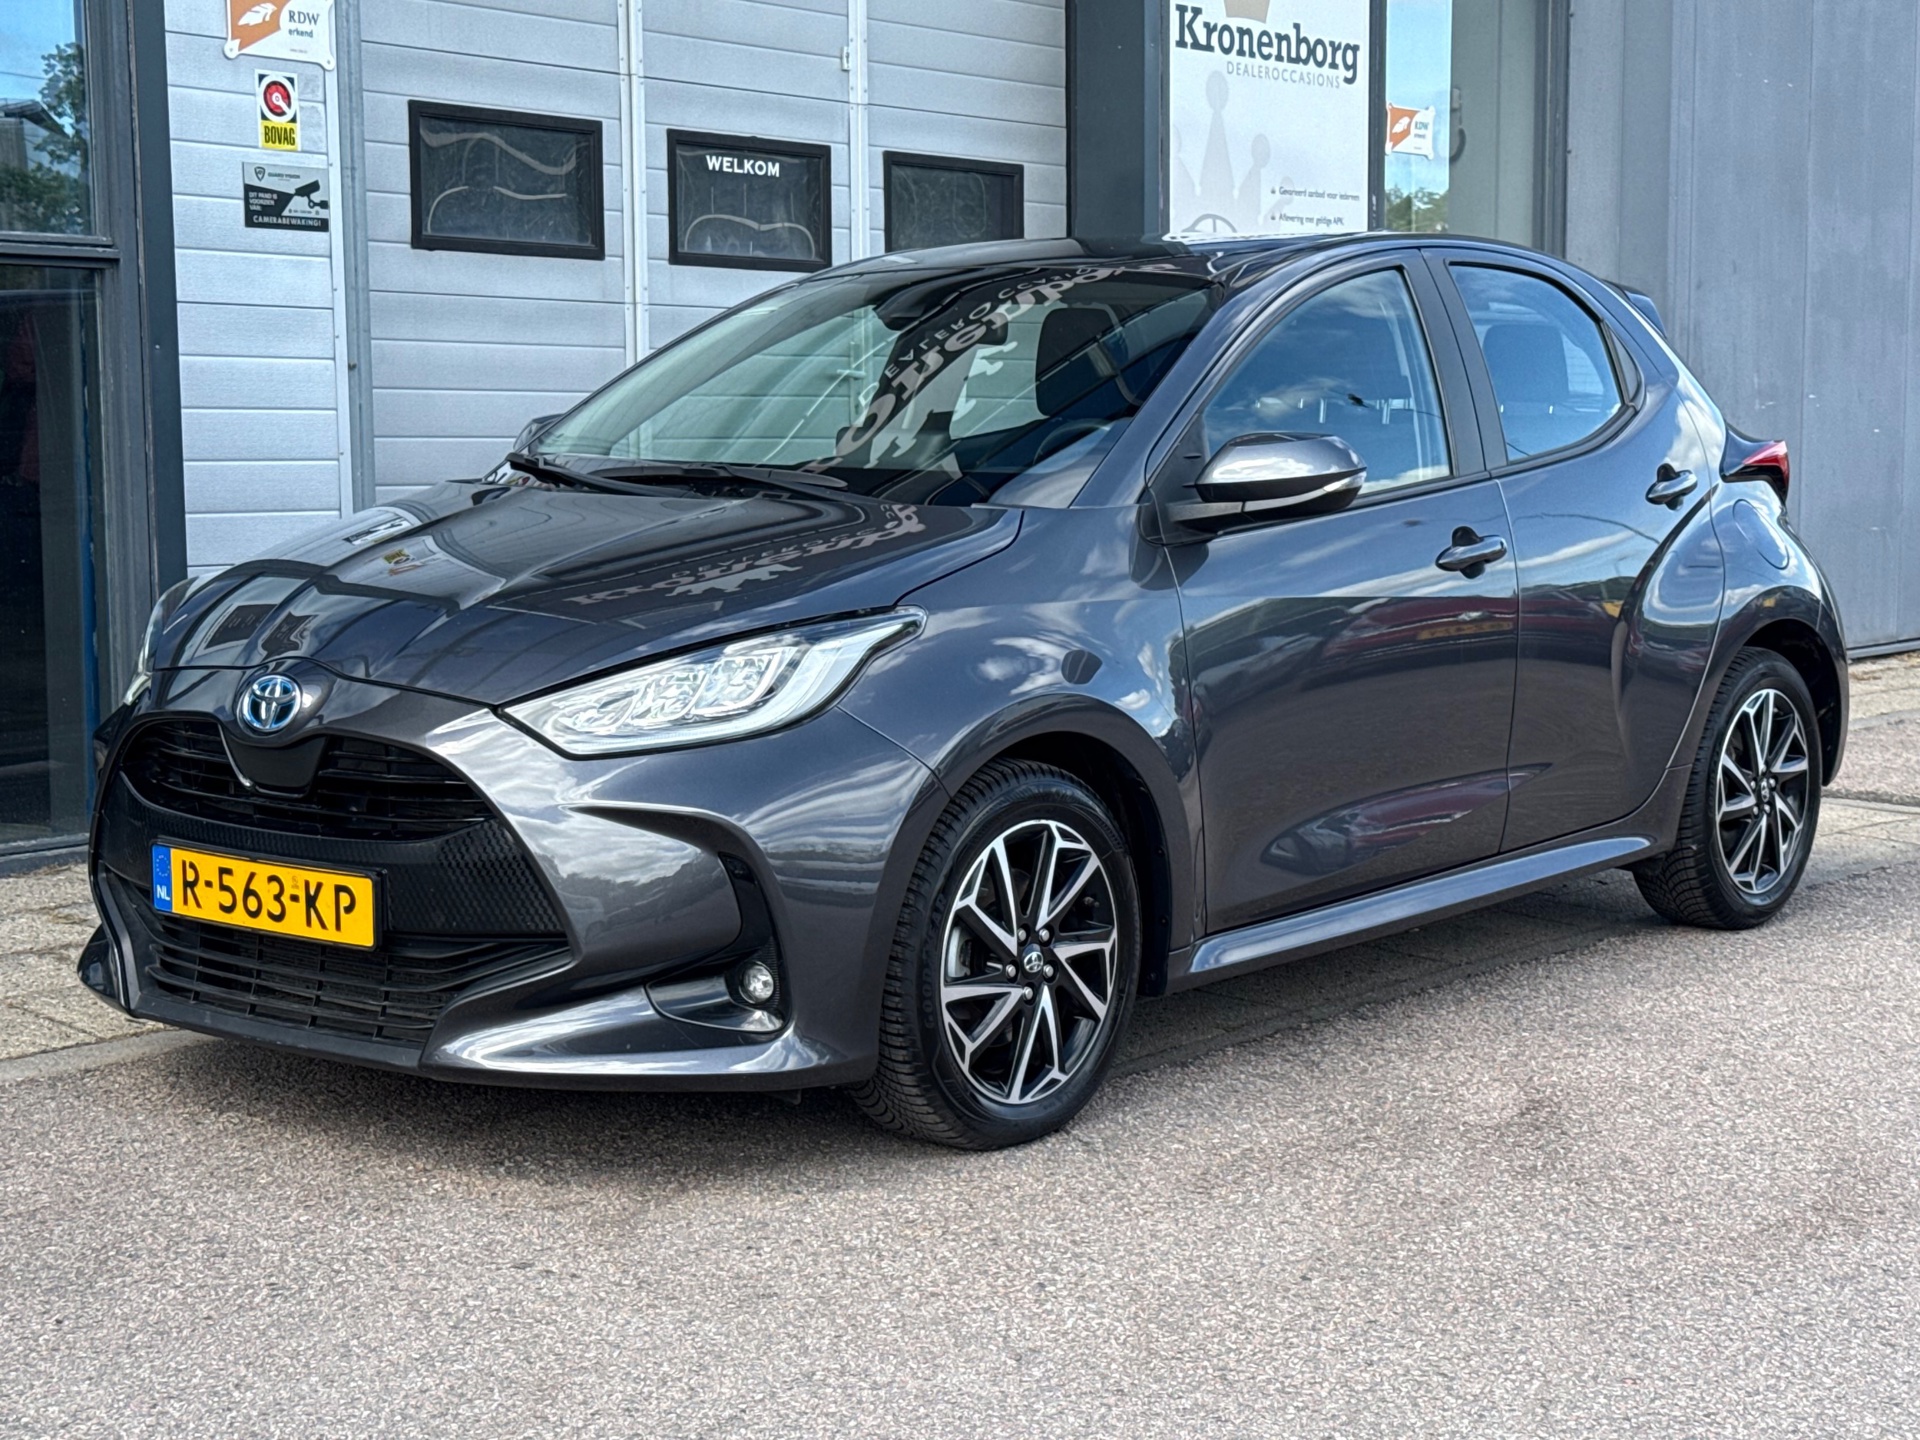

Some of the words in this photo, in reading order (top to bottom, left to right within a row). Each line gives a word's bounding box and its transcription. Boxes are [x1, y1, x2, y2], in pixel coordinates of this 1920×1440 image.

[288, 10, 320, 26] RDW
[288, 27, 314, 38] erkend
[1175, 4, 1360, 85] Kronenborg
[1227, 61, 1340, 89] DEALEROCCASIONS
[264, 125, 296, 146] BOVAG
[705, 155, 780, 177] WELKOM
[156, 885, 170, 900] NL
[181, 859, 357, 932] R-563-KP
